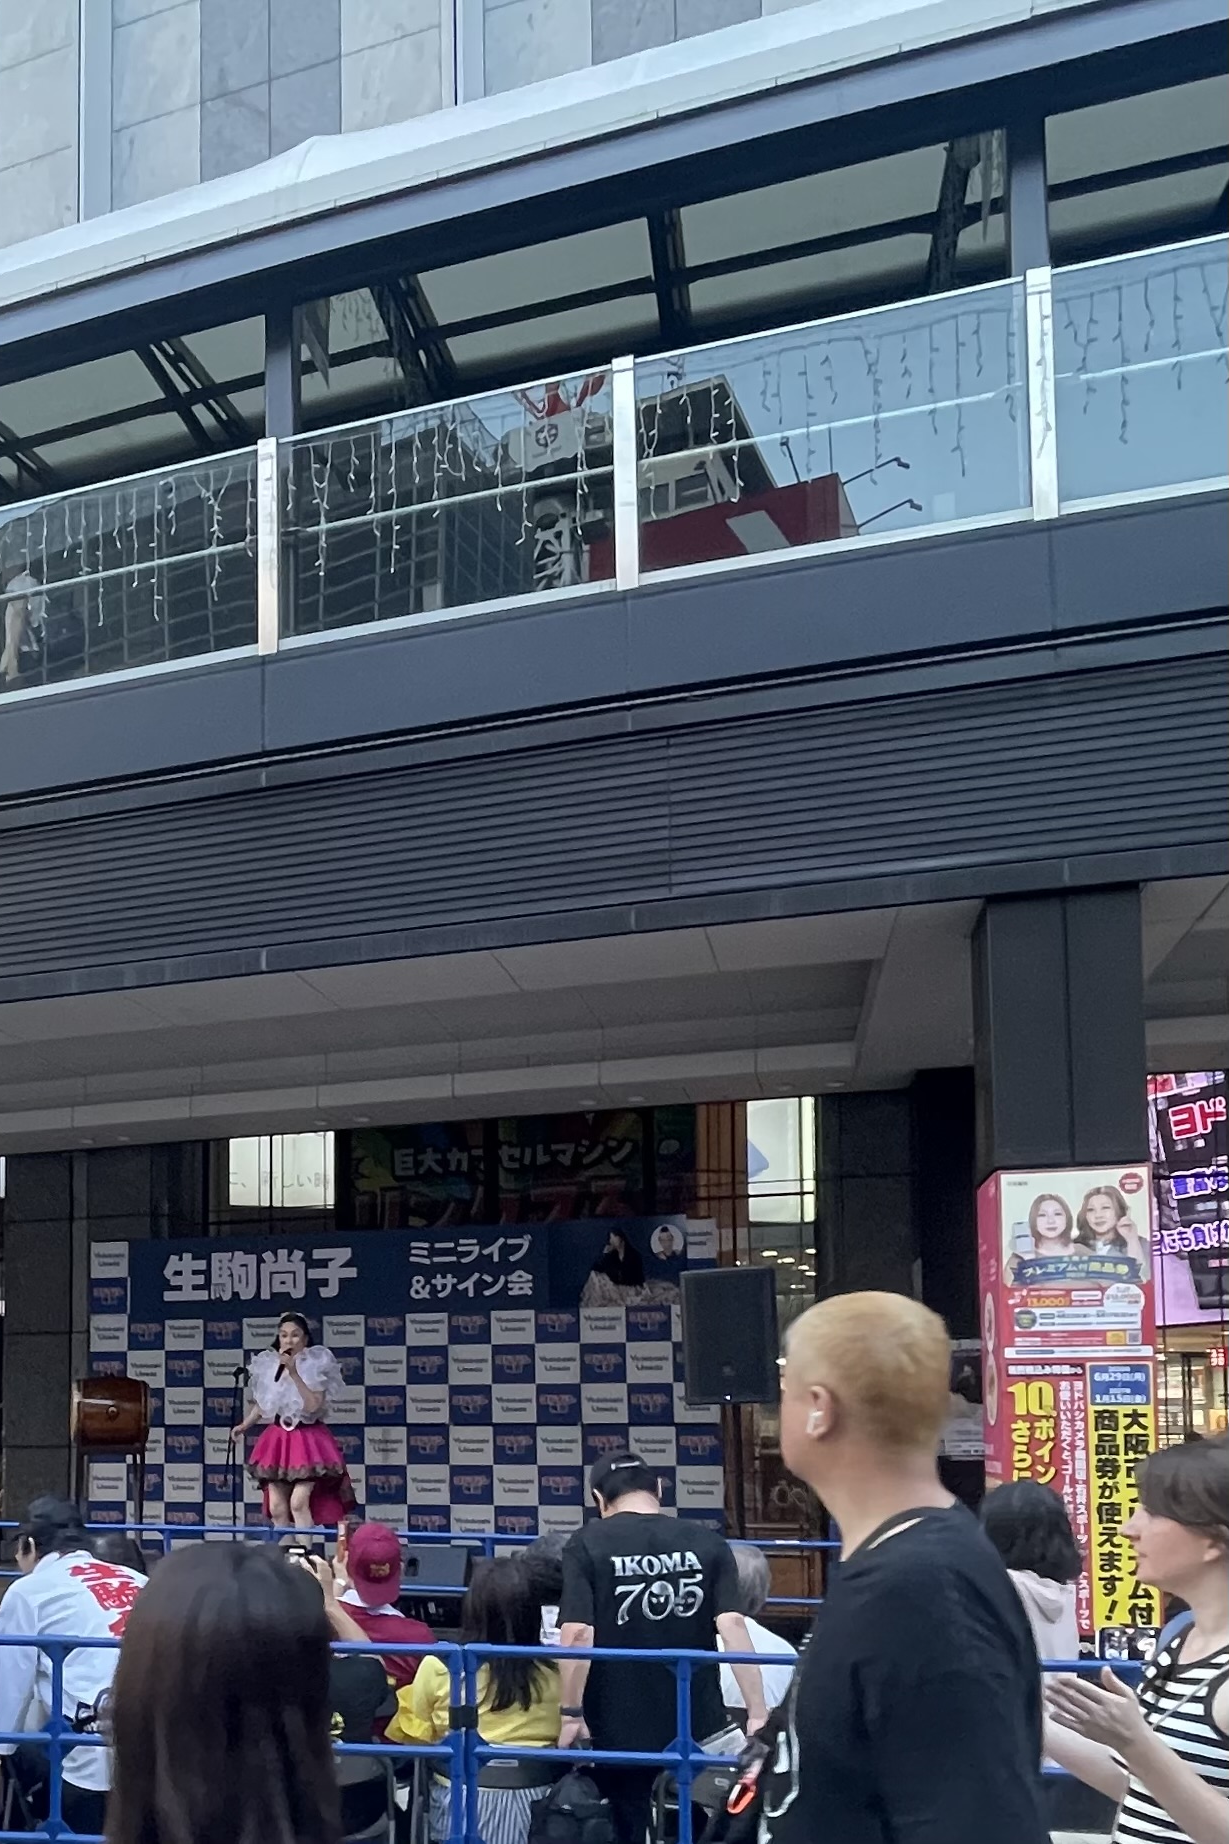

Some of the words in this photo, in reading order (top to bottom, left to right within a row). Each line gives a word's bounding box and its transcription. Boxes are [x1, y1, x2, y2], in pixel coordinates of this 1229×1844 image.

[409, 1234, 532, 1265] ミニライブ
[163, 1247, 358, 1301] 生駒尚子
[409, 1269, 533, 1299] &サイン会
[611, 1550, 703, 1577] IKOMA
[614, 1574, 705, 1626] 705
